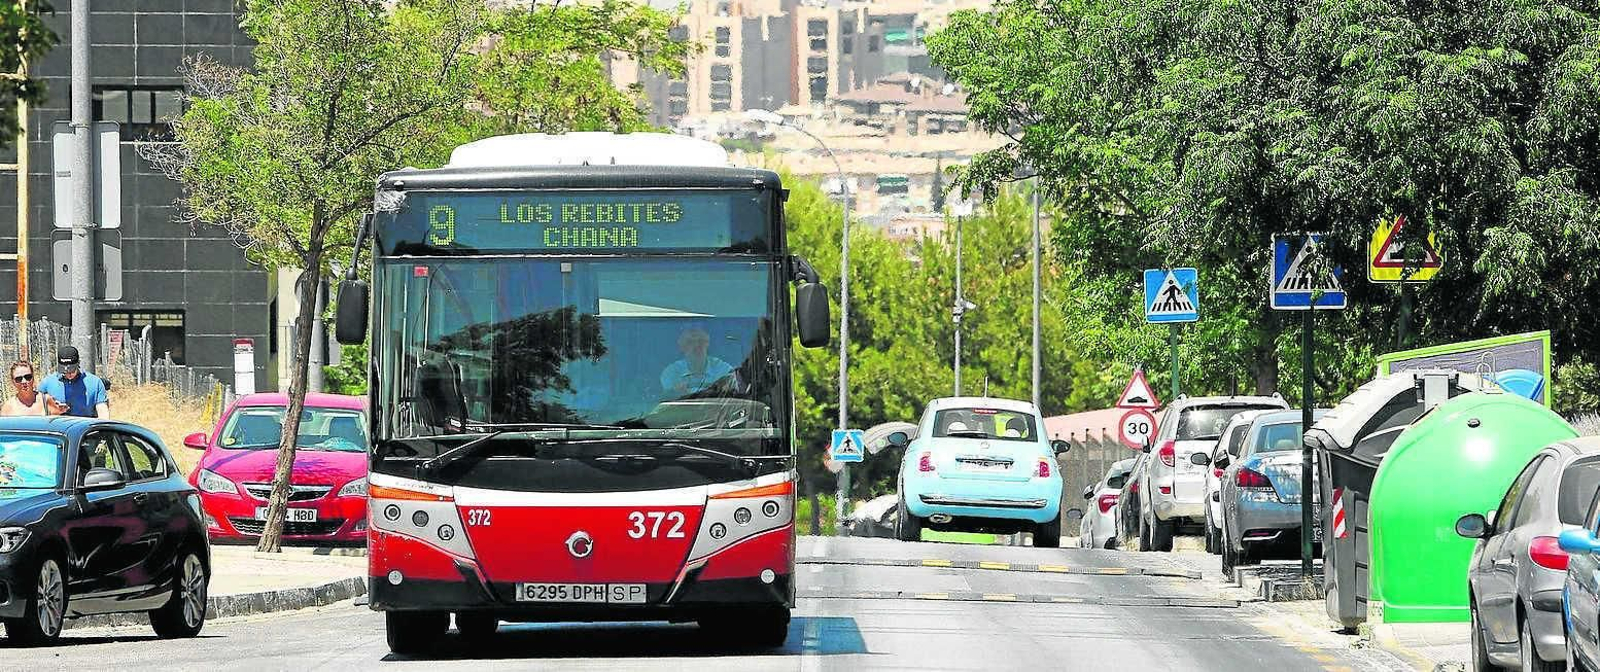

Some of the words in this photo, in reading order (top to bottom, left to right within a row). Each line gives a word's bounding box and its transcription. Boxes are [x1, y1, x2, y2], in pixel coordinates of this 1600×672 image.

[500, 203, 553, 223] LOS
[561, 203, 683, 223] REBITES
[429, 205, 456, 246] 9
[543, 226, 639, 247] CHANA
[1128, 422, 1149, 435] 30
[468, 509, 491, 526] 372
[627, 511, 686, 539] 372
[526, 585, 568, 600] 6295
[572, 585, 604, 600] DPH
[613, 586, 641, 601] SP
